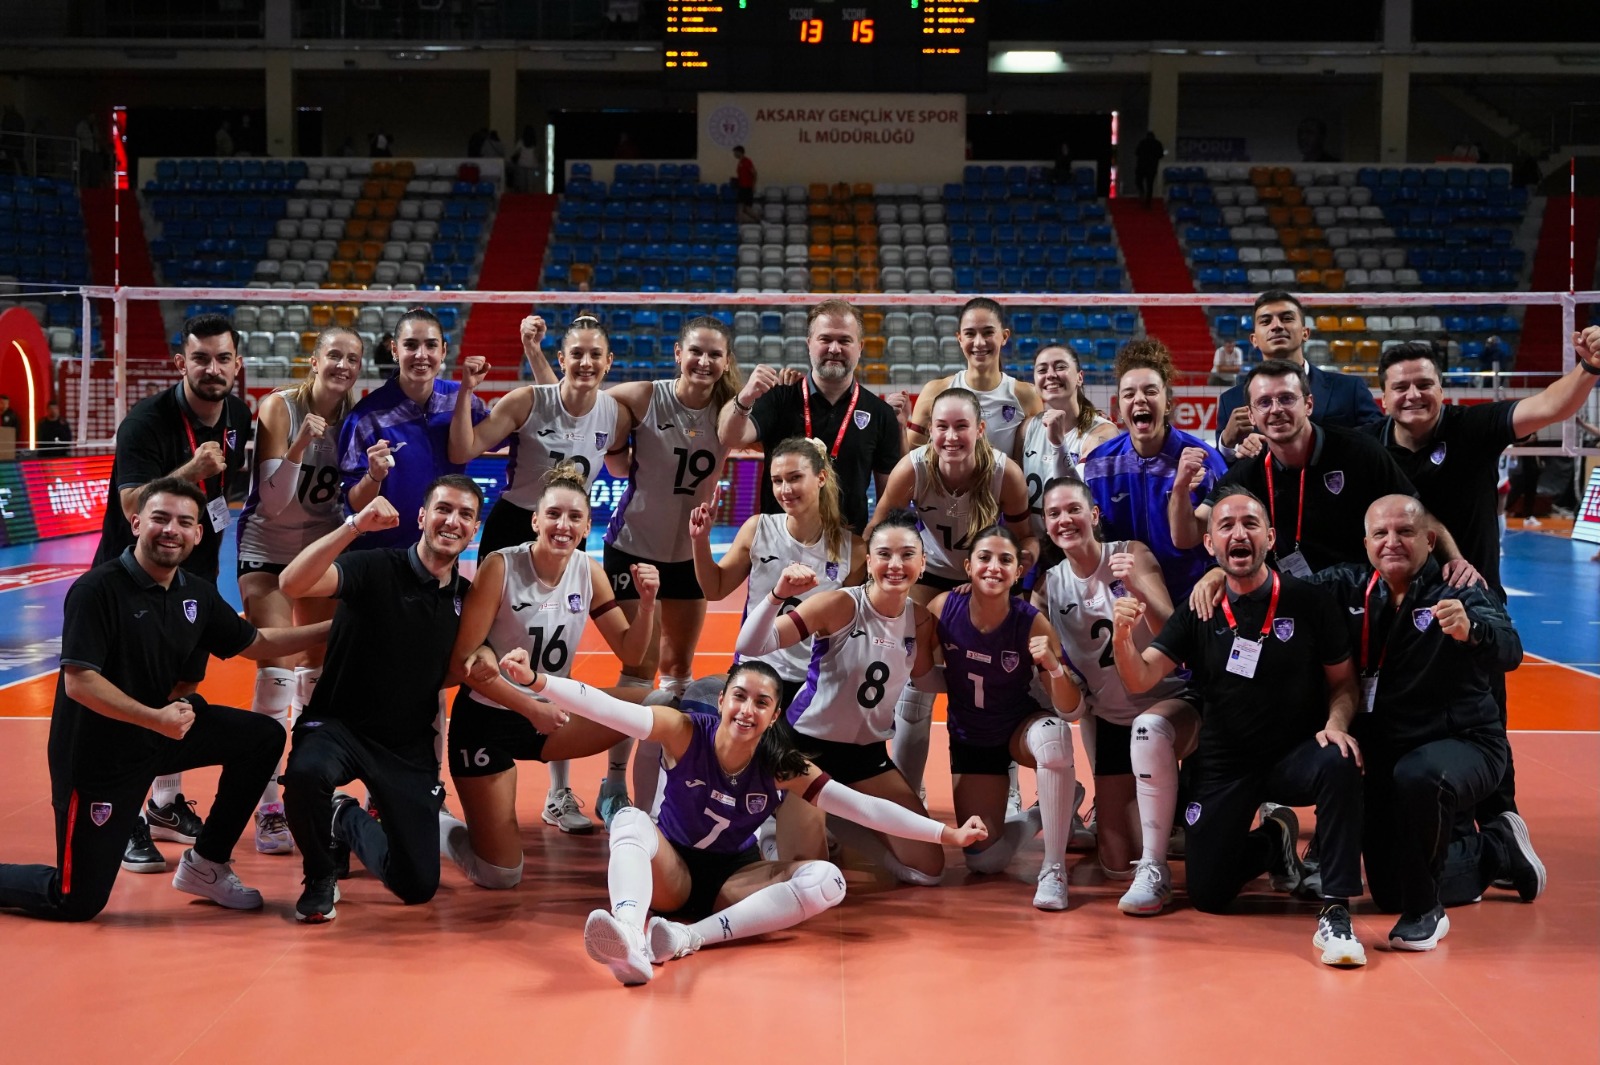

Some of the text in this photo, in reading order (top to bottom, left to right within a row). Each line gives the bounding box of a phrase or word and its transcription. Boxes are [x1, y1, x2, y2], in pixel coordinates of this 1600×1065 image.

[800, 19, 823, 43] 13
[852, 19, 874, 43] 15
[756, 107, 958, 125] AKSARAY GENÇLİK VE SPOR
[799, 128, 915, 145] İL MÜDÜRLÜĞÜ
[673, 447, 716, 488] 19
[298, 463, 339, 505] 18
[612, 572, 631, 591] 19
[528, 624, 568, 673] 16
[856, 661, 890, 709] 8
[968, 672, 984, 709] 1
[460, 747, 490, 768] 16
[693, 807, 731, 850] 7
